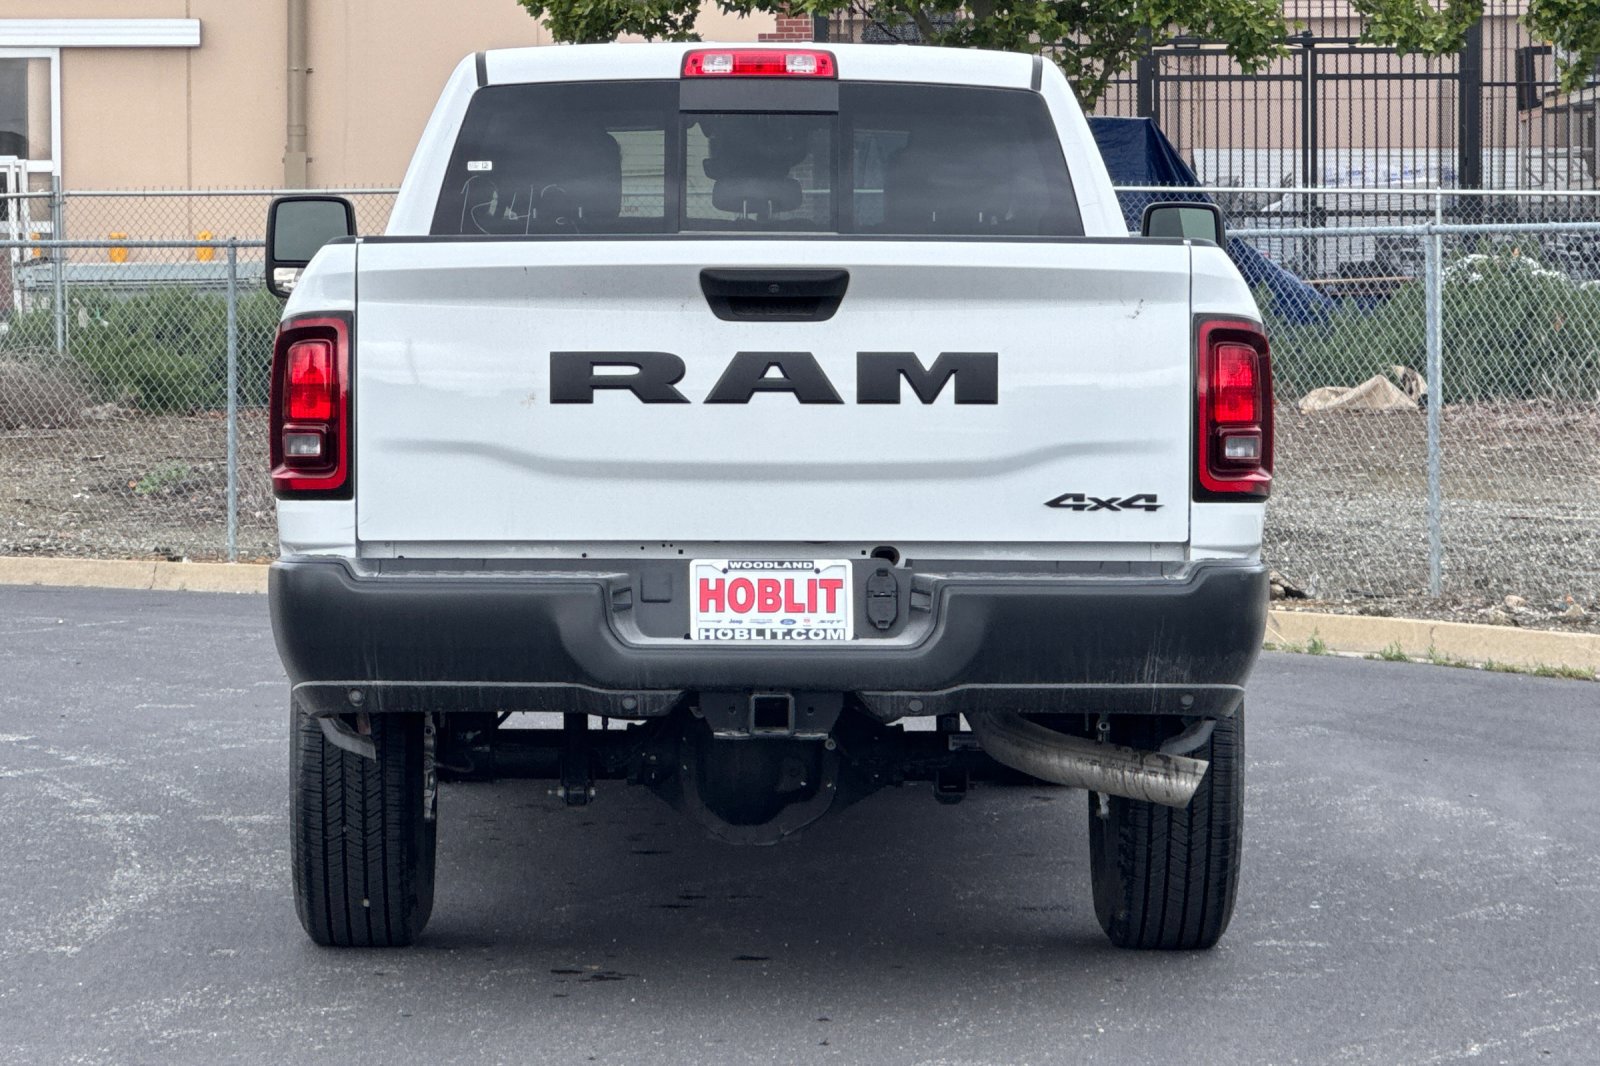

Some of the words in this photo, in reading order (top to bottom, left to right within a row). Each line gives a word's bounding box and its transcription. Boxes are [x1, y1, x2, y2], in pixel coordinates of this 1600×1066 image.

[550, 351, 998, 404] RAM
[1043, 493, 1165, 511] 4x4
[729, 561, 814, 569] WOODLAND
[699, 578, 843, 613] HOBLIT
[699, 628, 844, 640] HOBLIT.COM
